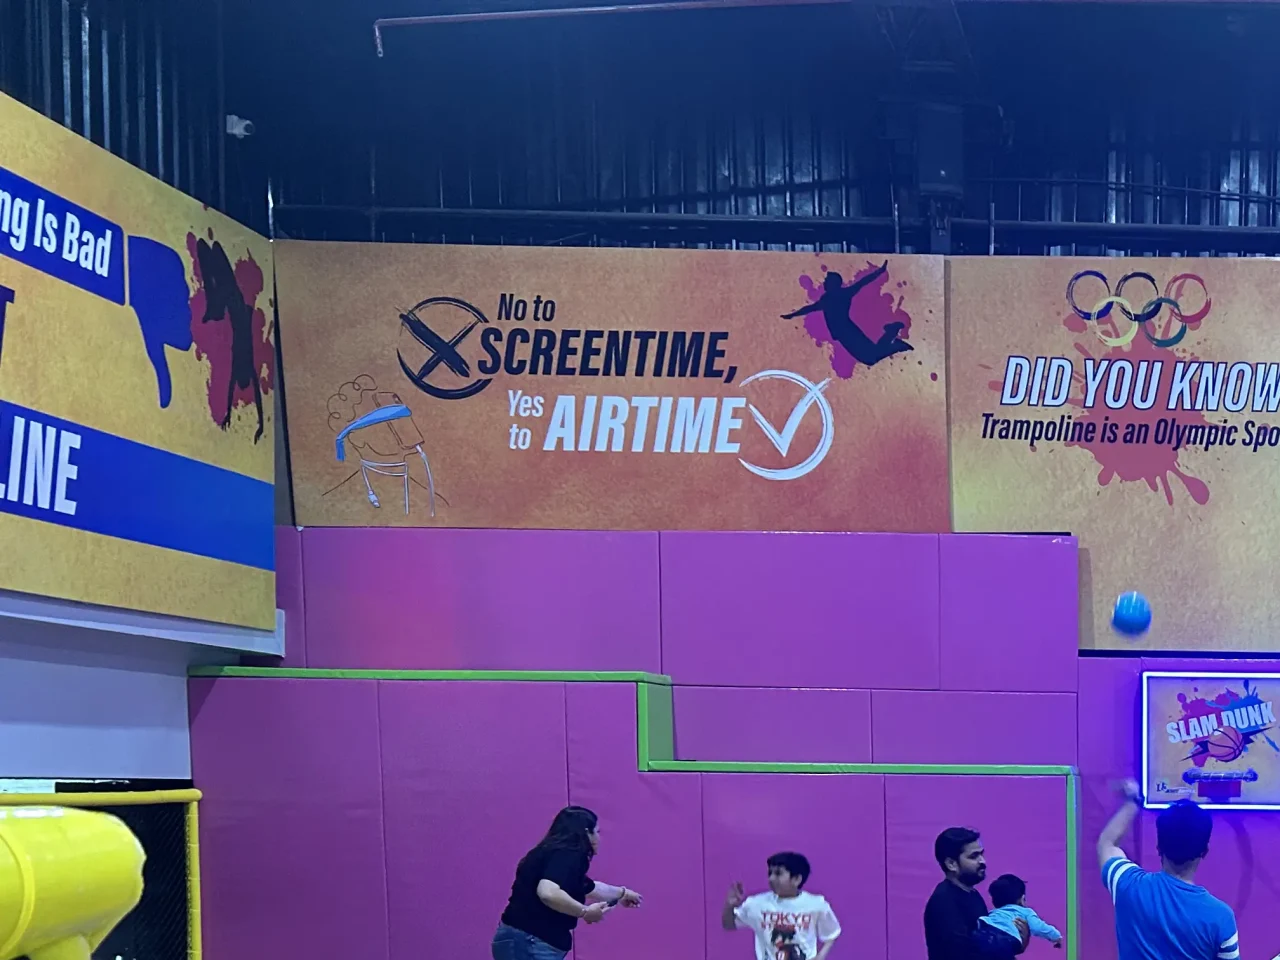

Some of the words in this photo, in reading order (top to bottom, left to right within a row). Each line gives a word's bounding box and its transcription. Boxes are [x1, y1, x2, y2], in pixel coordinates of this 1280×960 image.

[33, 198, 58, 253] Is
[62, 211, 112, 277] Bad
[497, 293, 528, 321] No
[532, 295, 556, 322] to
[477, 327, 738, 384] SCREENTIME,
[1000, 356, 1073, 407] DID
[1084, 359, 1164, 410] YOU
[508, 390, 544, 417] Yes
[509, 423, 531, 450] to
[542, 395, 747, 454] AIRTIME
[981, 413, 1096, 446] Trampoline
[1100, 420, 1118, 444] is
[1123, 424, 1150, 445] an
[1154, 418, 1239, 451] Olympic
[1166, 714, 1218, 743] SLAM
[1221, 701, 1277, 730] DUNK
[761, 911, 811, 924] TOKYO
